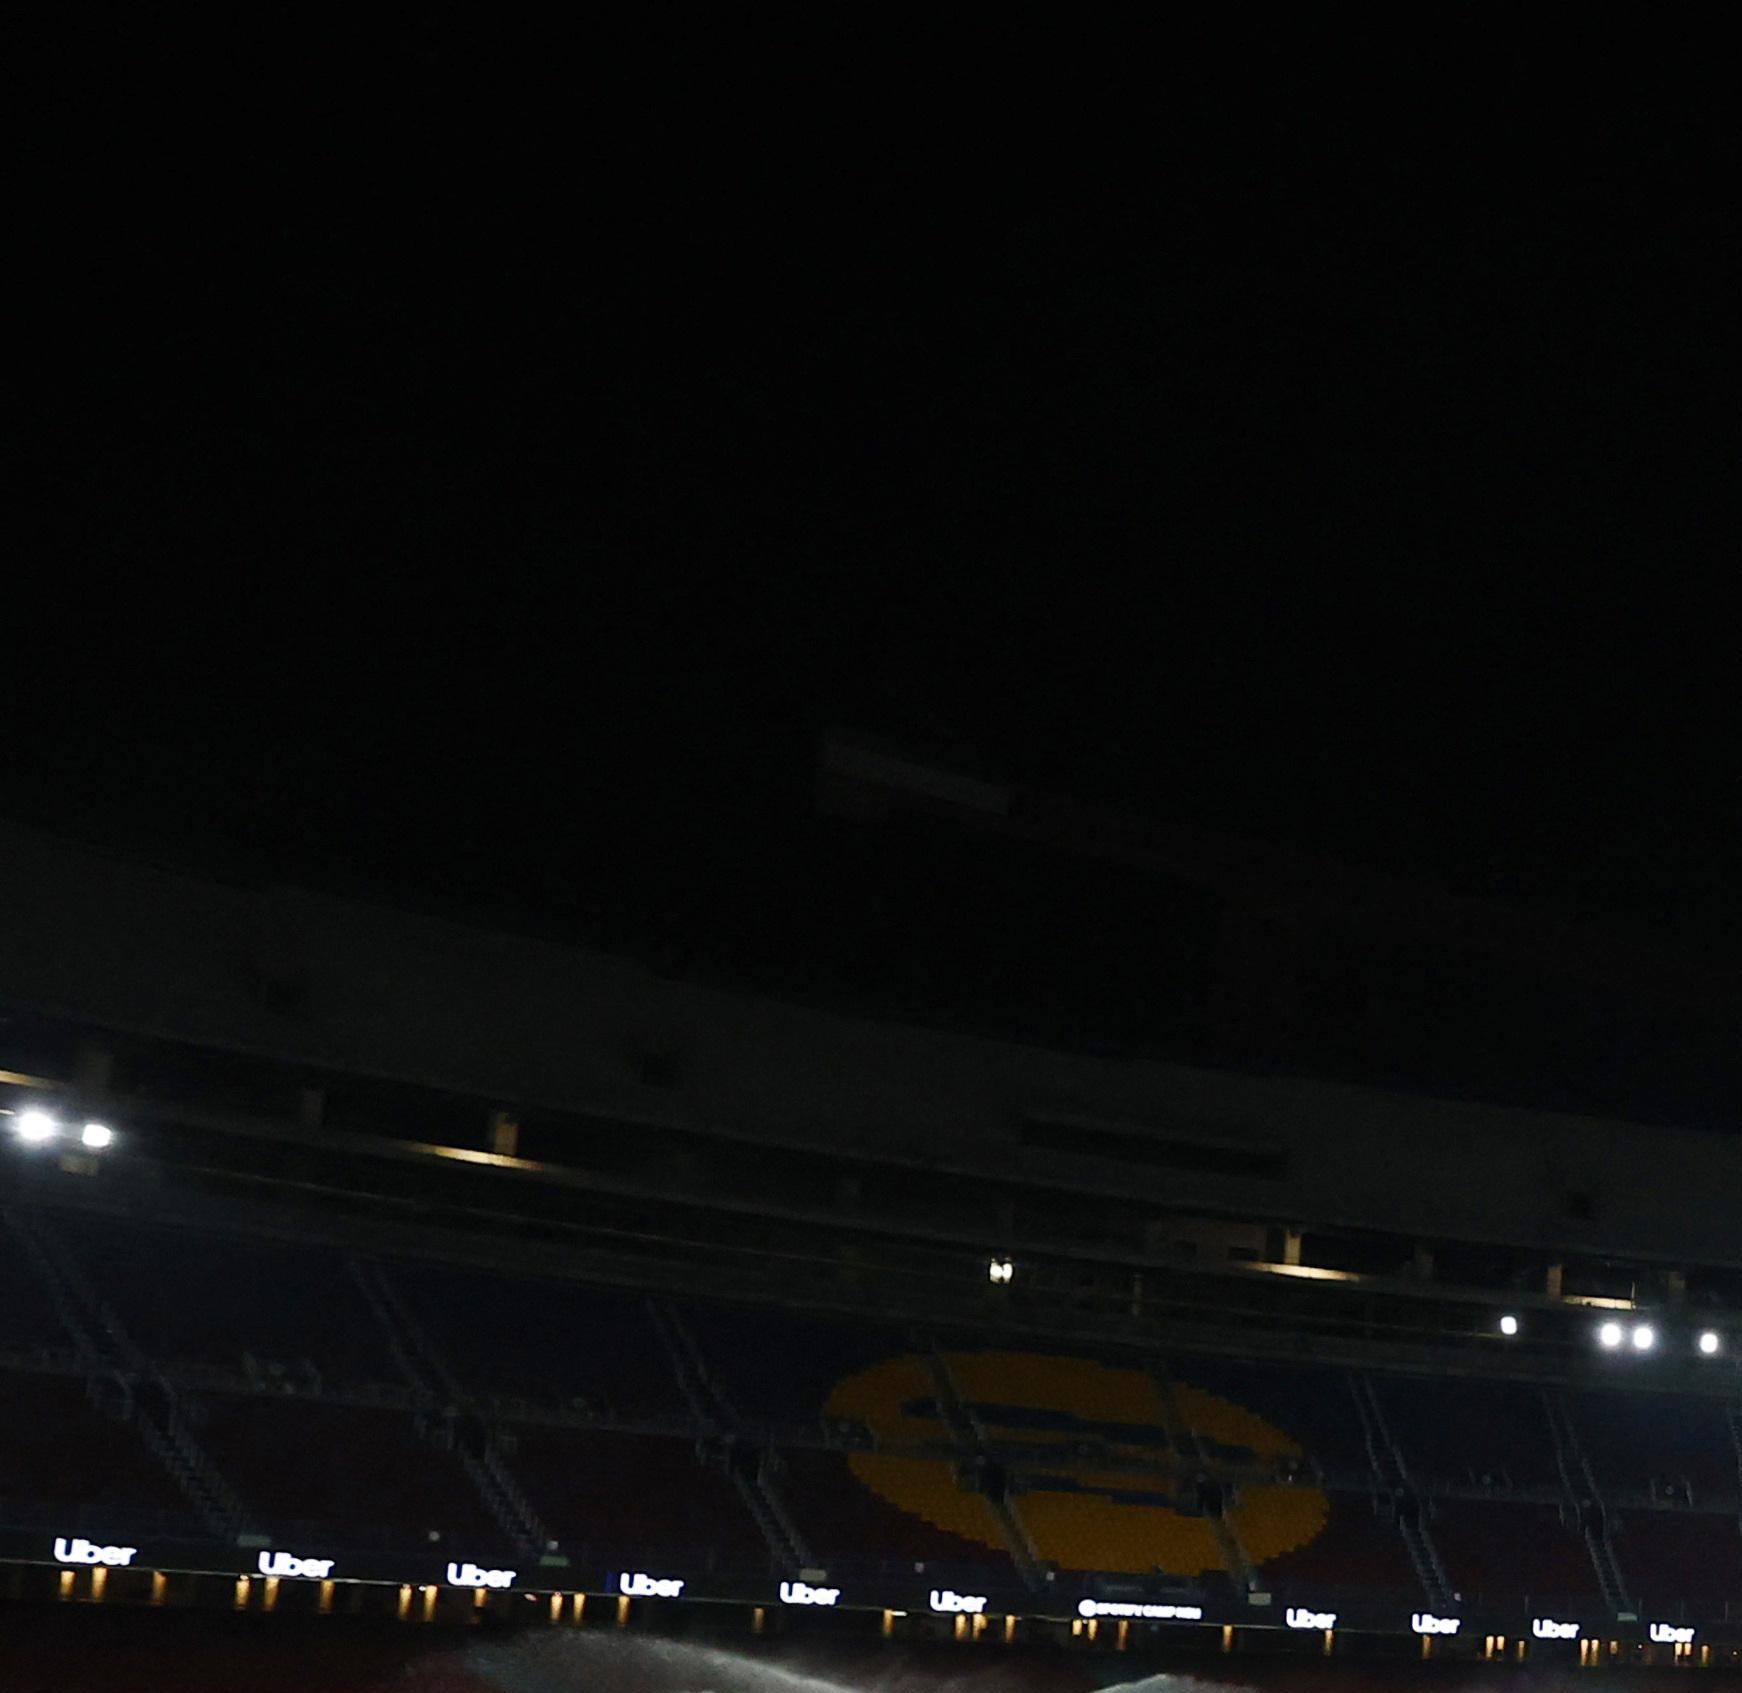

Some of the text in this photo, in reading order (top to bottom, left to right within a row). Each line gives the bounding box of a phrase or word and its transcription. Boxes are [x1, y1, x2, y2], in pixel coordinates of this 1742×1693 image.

[54, 1538, 136, 1565] Uber
[259, 1551, 334, 1578] Uber
[447, 1563, 516, 1587] Uber
[620, 1573, 684, 1597] Uber
[780, 1582, 840, 1605] Uber
[930, 1591, 987, 1612] Uber
[1286, 1608, 1336, 1629] Uber
[1412, 1614, 1460, 1634] Uber
[1533, 1619, 1579, 1638] Uber
[1650, 1624, 1694, 1642] Uber
